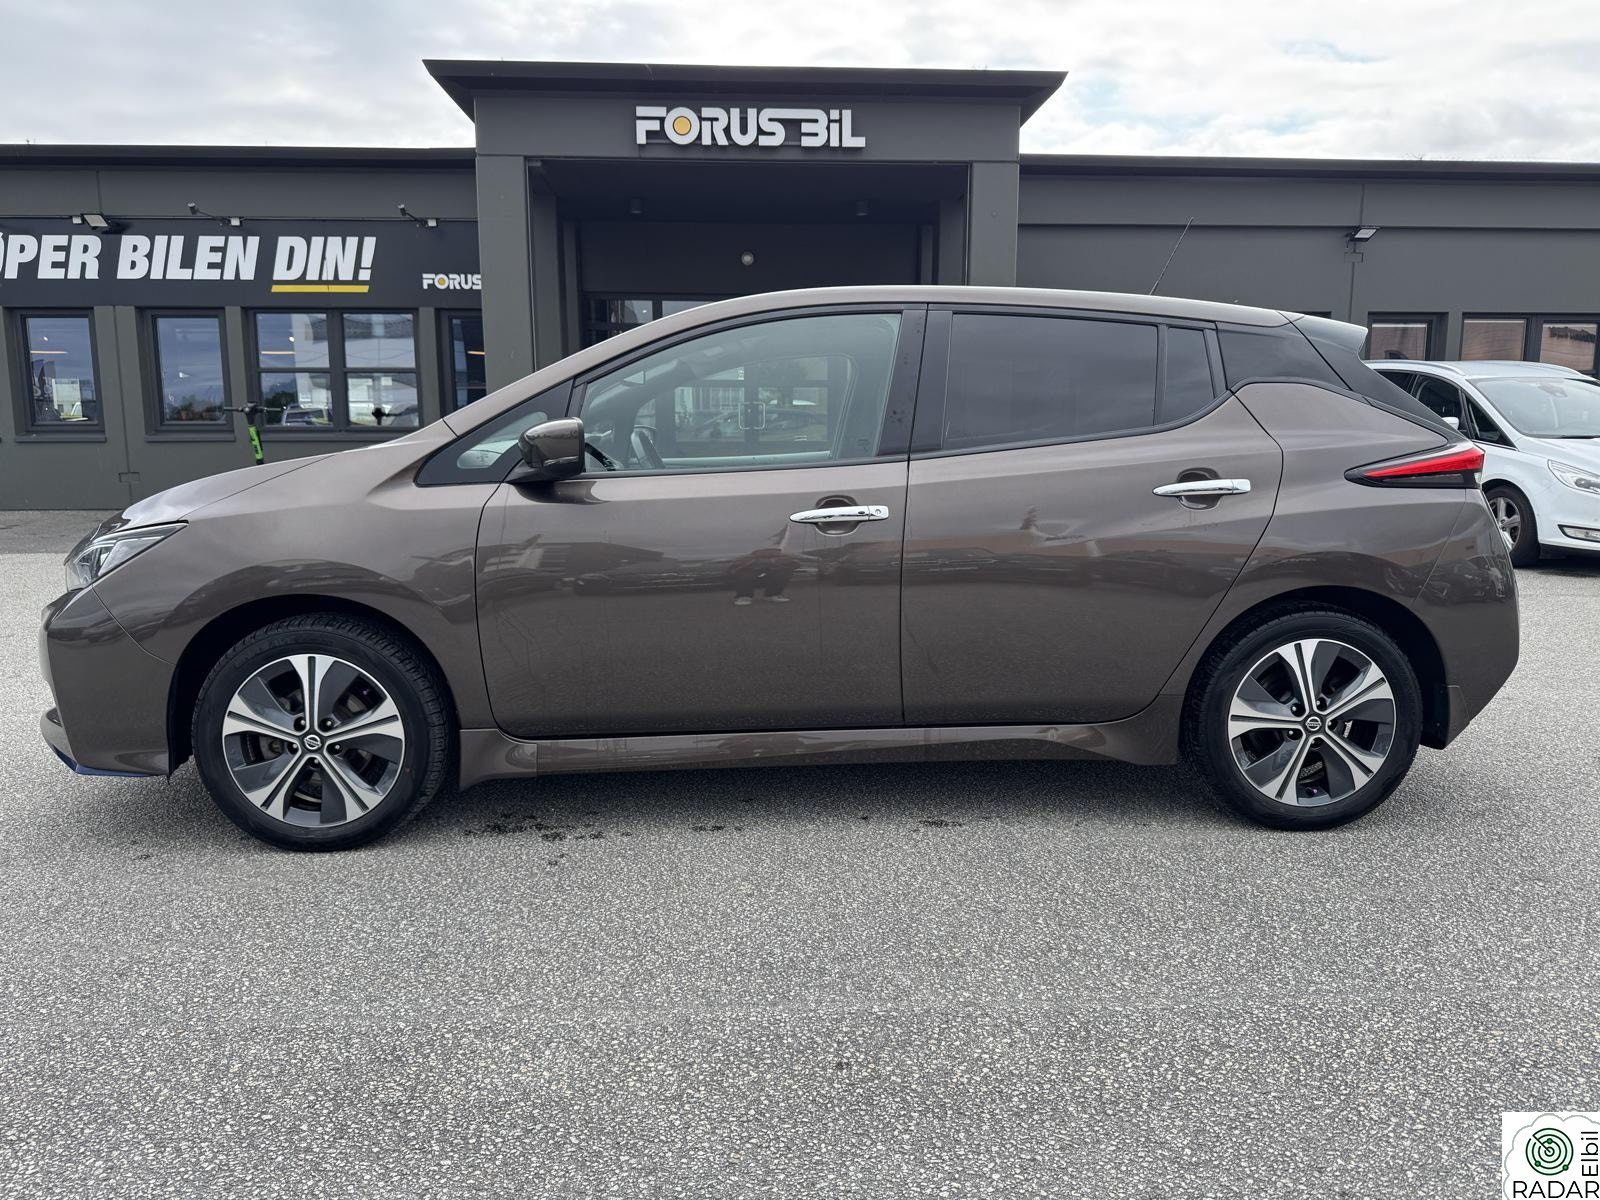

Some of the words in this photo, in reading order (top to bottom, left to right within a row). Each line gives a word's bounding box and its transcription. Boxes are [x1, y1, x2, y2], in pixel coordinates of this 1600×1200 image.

[636, 106, 786, 146] FORUS
[0, 231, 102, 279] PER
[117, 235, 260, 280] BILEN
[272, 236, 377, 281] DIN!
[422, 273, 482, 290] FORUS
